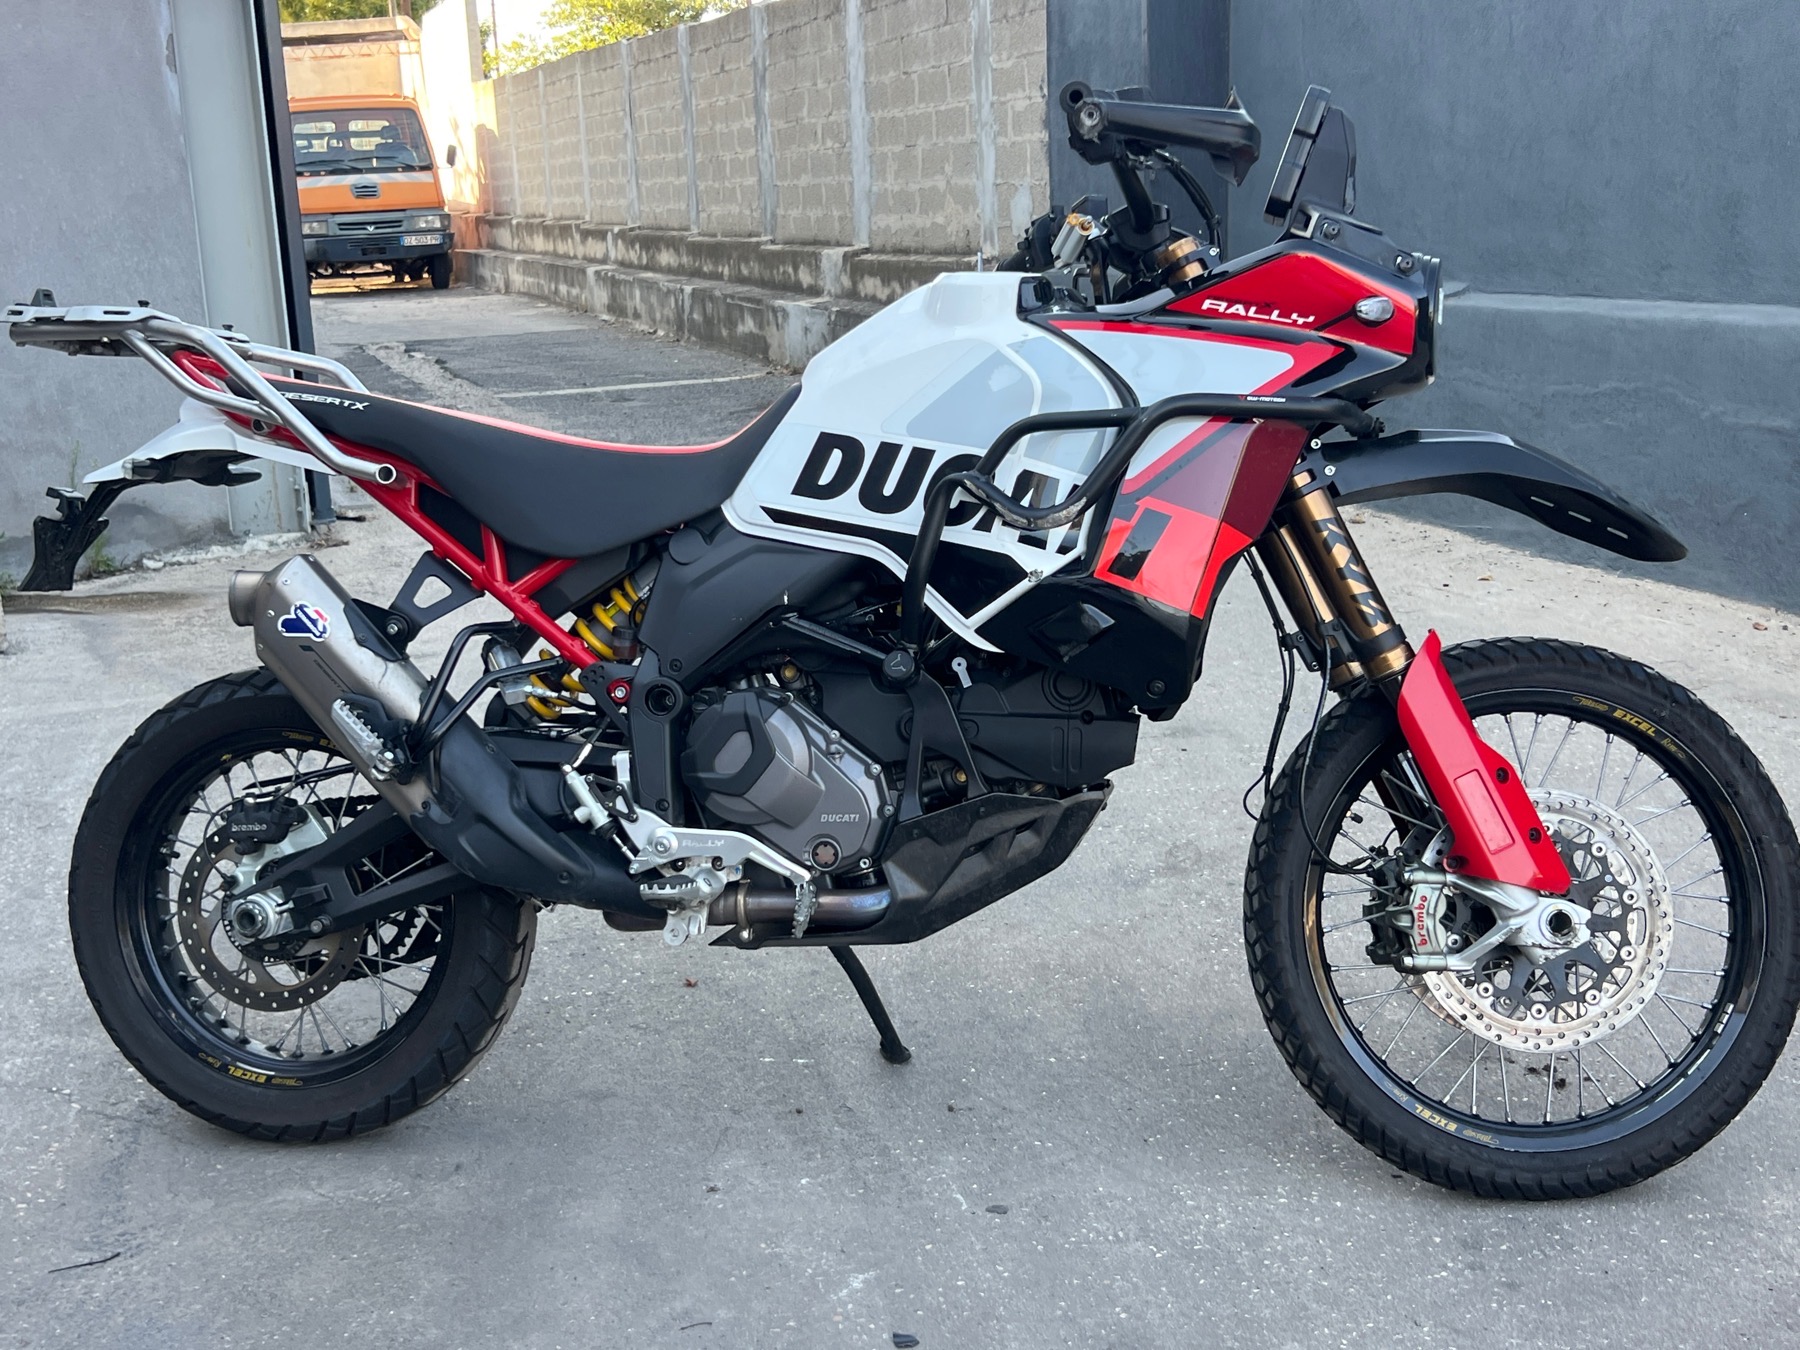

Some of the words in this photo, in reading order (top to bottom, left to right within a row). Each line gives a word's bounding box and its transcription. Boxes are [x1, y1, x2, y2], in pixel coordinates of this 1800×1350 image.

[1201, 299, 1315, 325] RALLY
[1311, 516, 1391, 629] KYB
[1613, 709, 1656, 737] EXCEL
[231, 822, 268, 832] brembo
[820, 813, 860, 823] DUCATI
[1414, 895, 1428, 947] brembo
[228, 1065, 268, 1084] EXCEL
[1415, 1103, 1458, 1132] EXCEL
